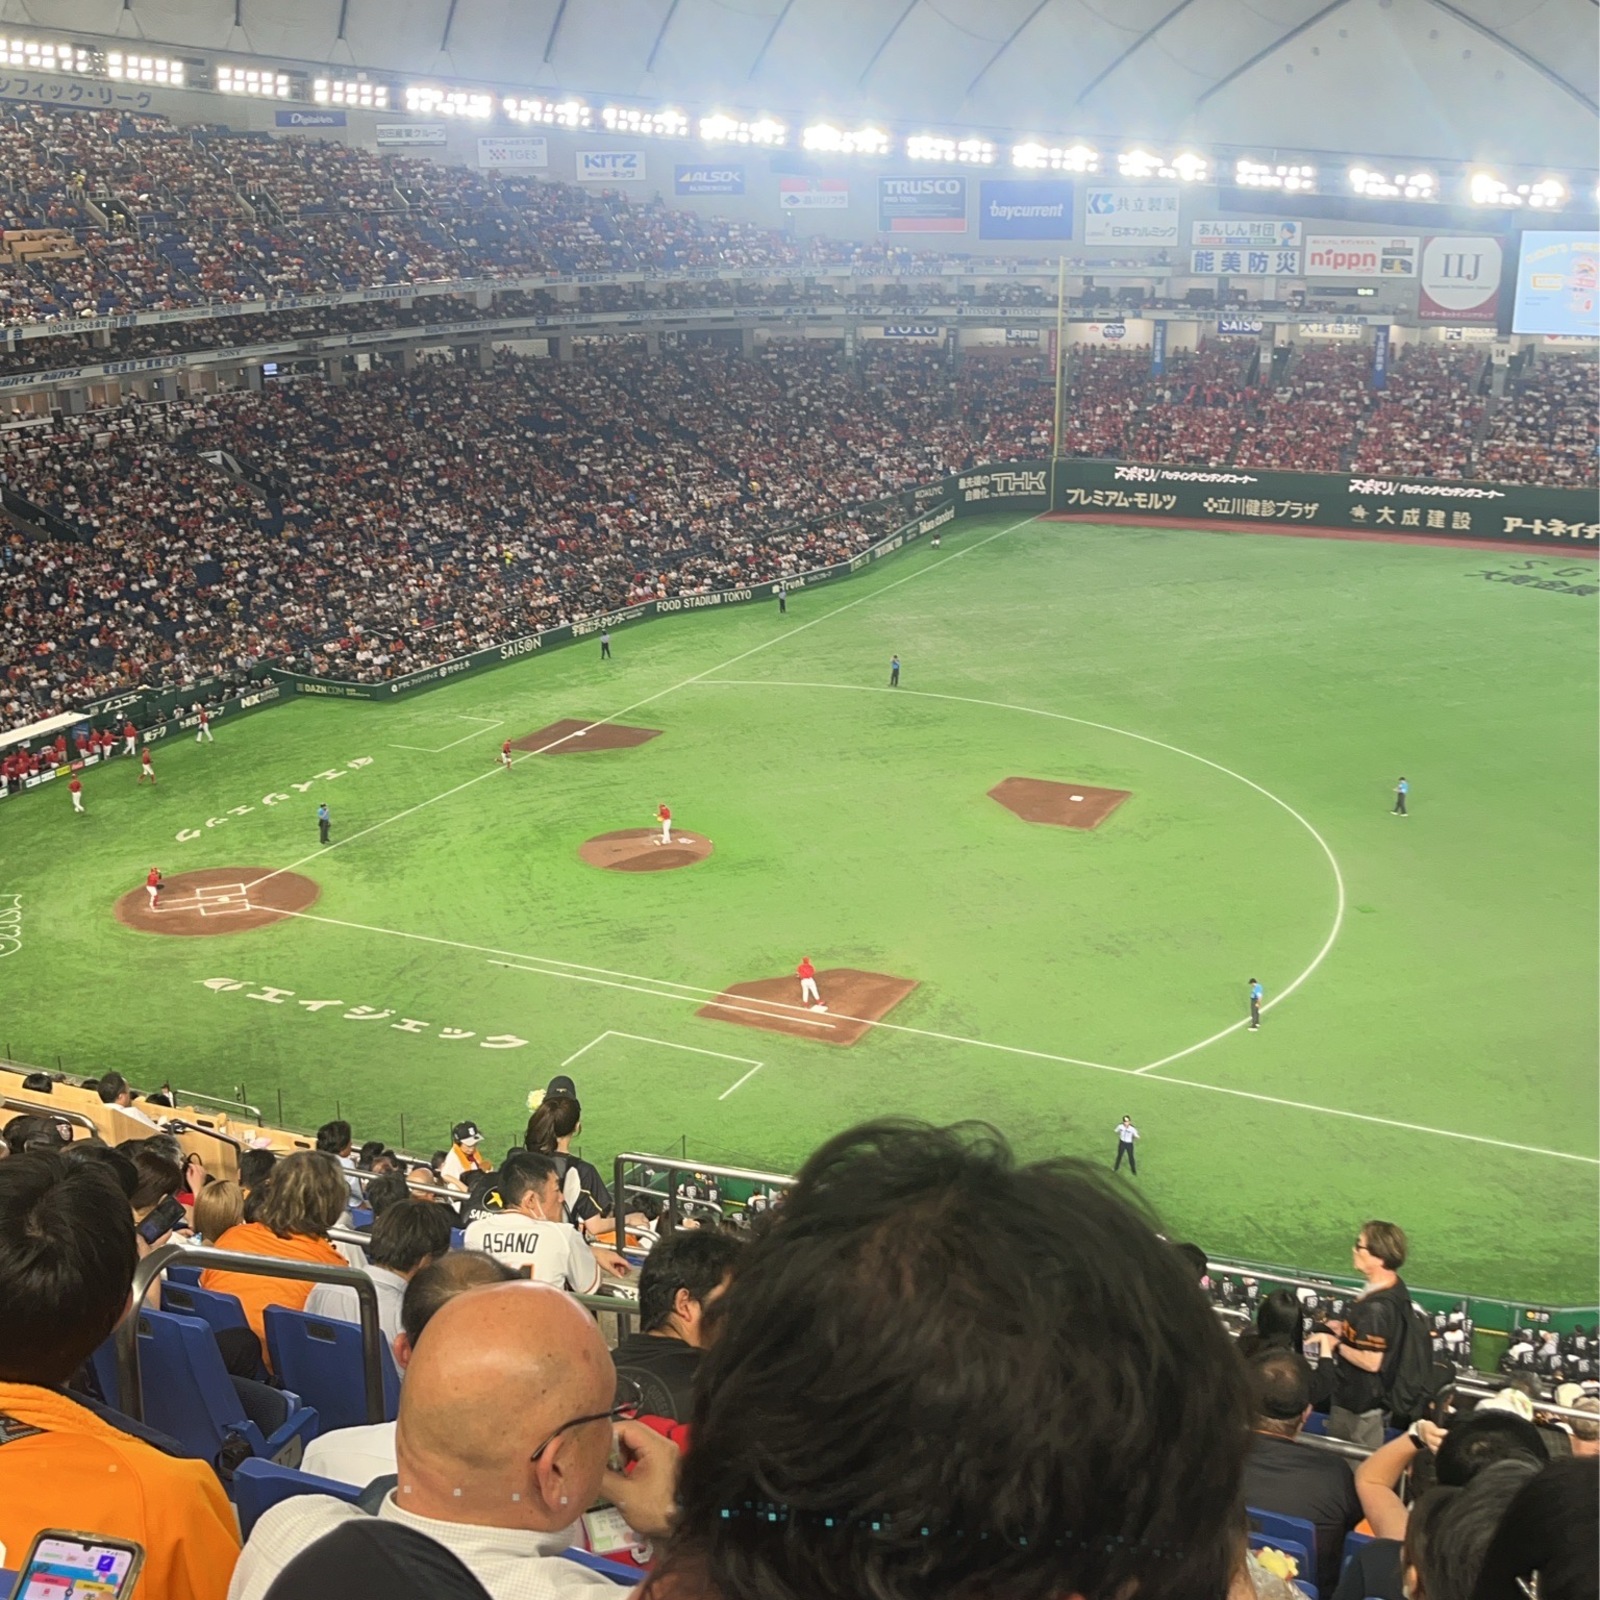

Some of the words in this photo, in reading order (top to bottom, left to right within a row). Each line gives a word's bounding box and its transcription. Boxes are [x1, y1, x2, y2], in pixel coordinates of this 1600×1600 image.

[508, 149, 537, 160] TGES
[584, 153, 637, 168] KITZ
[691, 171, 741, 183] ALSOK
[883, 180, 961, 195] TRUSCO
[989, 200, 1064, 220] baycurrent
[1117, 194, 1177, 212] 共立製薬
[1111, 226, 1177, 238] 日本カルミック
[1198, 222, 1275, 237] あんしん財団
[1194, 250, 1297, 274] 能美防災
[1310, 249, 1377, 271] nippn
[1442, 253, 1483, 281] IIJ
[1220, 321, 1264, 332] SAISO
[991, 471, 1047, 492] THK
[914, 486, 945, 499] KOKUYO
[1066, 488, 1177, 510] プレミアム・モルツ
[1216, 498, 1319, 519] 立川健診プラザ
[1375, 506, 1472, 530] 大成建設
[656, 599, 681, 613] FOOD
[683, 594, 721, 608] STADIUM
[724, 590, 751, 603] TOKYO
[500, 637, 542, 661] SAISON
[469, 1208, 500, 1220] SAPP
[483, 1233, 539, 1254] ASANO
